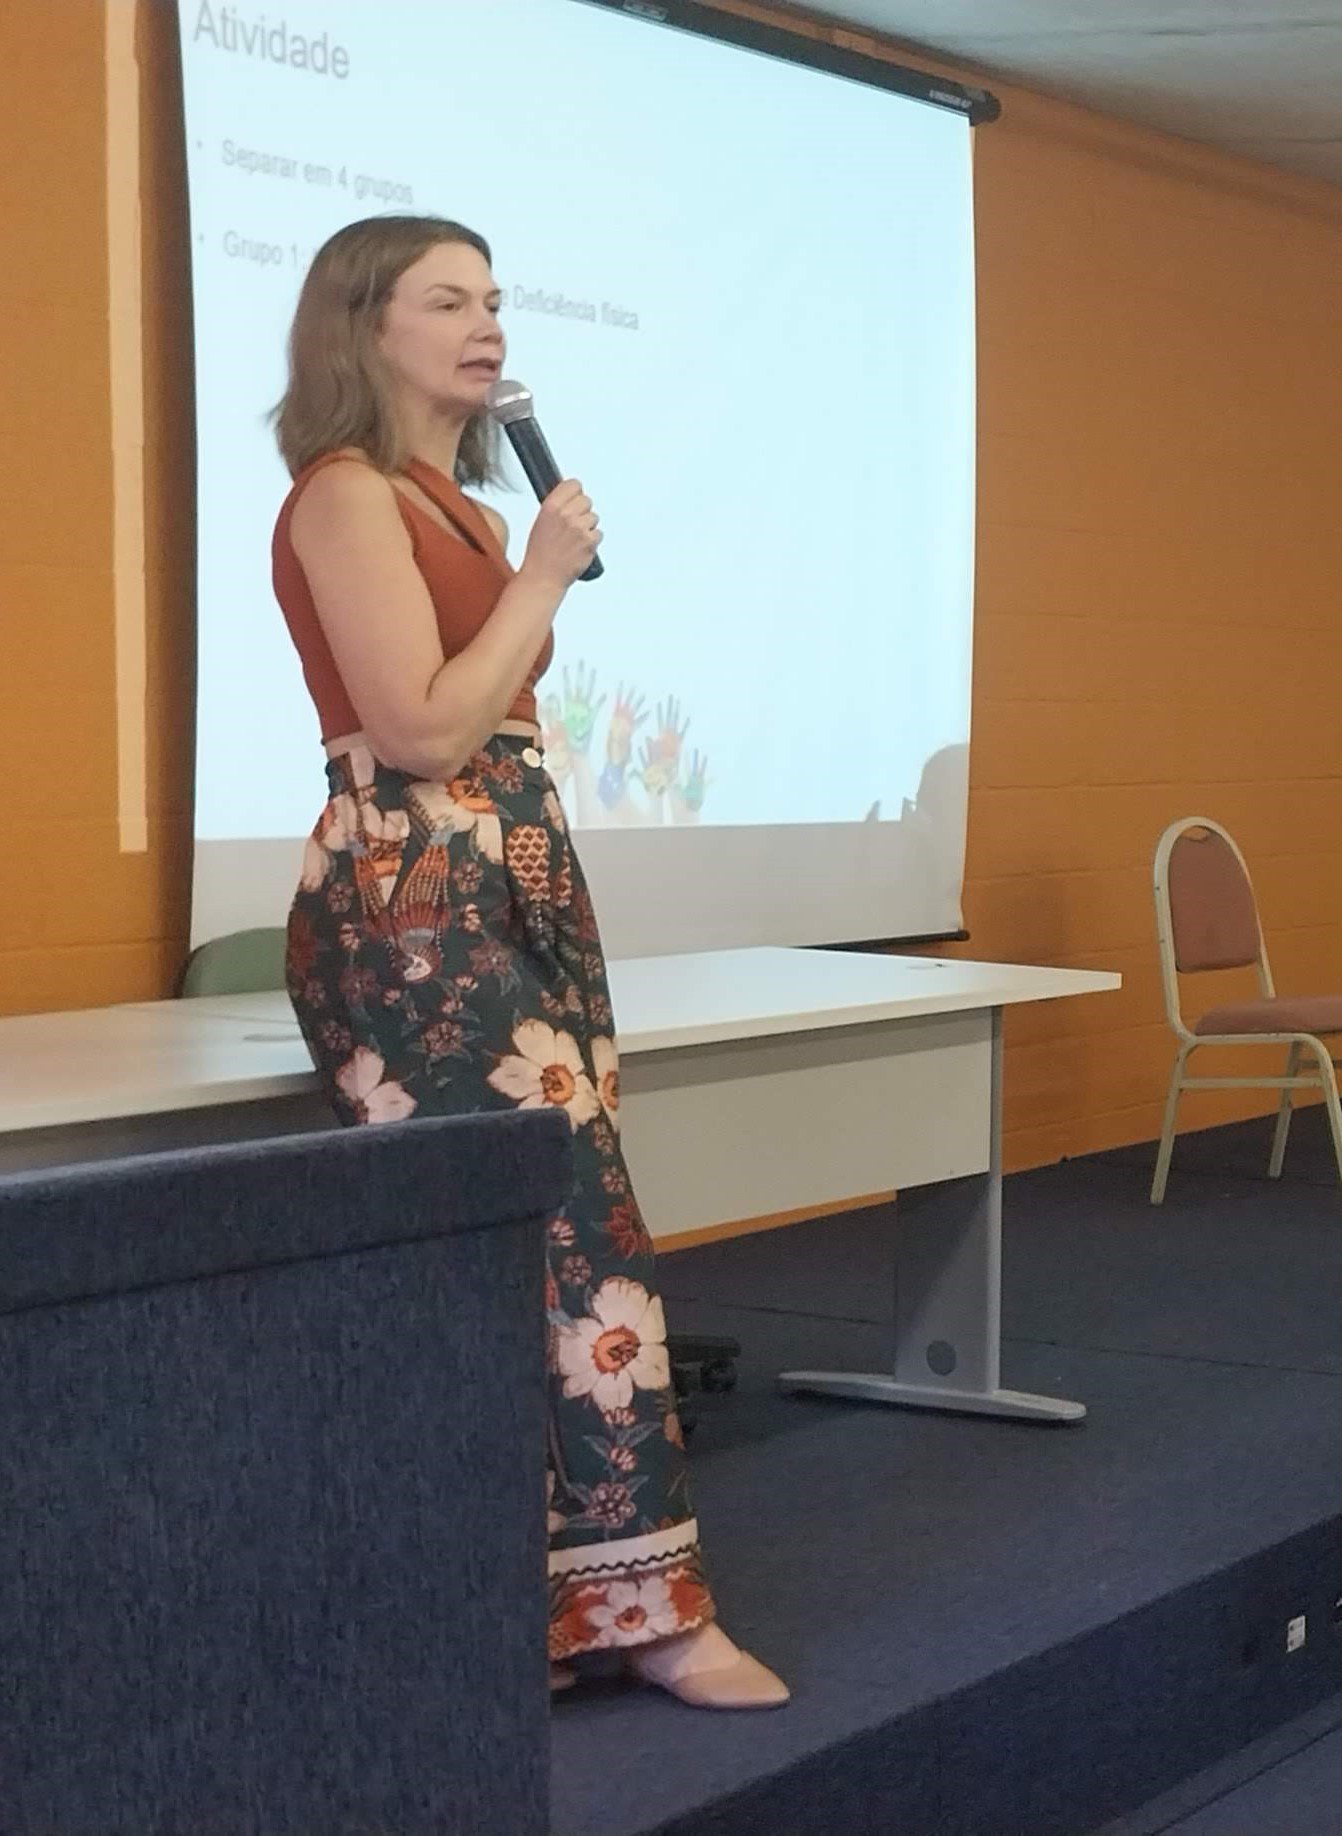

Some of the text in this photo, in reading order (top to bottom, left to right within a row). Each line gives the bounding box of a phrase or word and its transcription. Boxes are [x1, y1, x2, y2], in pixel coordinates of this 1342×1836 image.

[194, 0, 350, 80] Atividade
[222, 139, 414, 204] Separar em 4 grupos
[223, 230, 283, 267] Grupo
